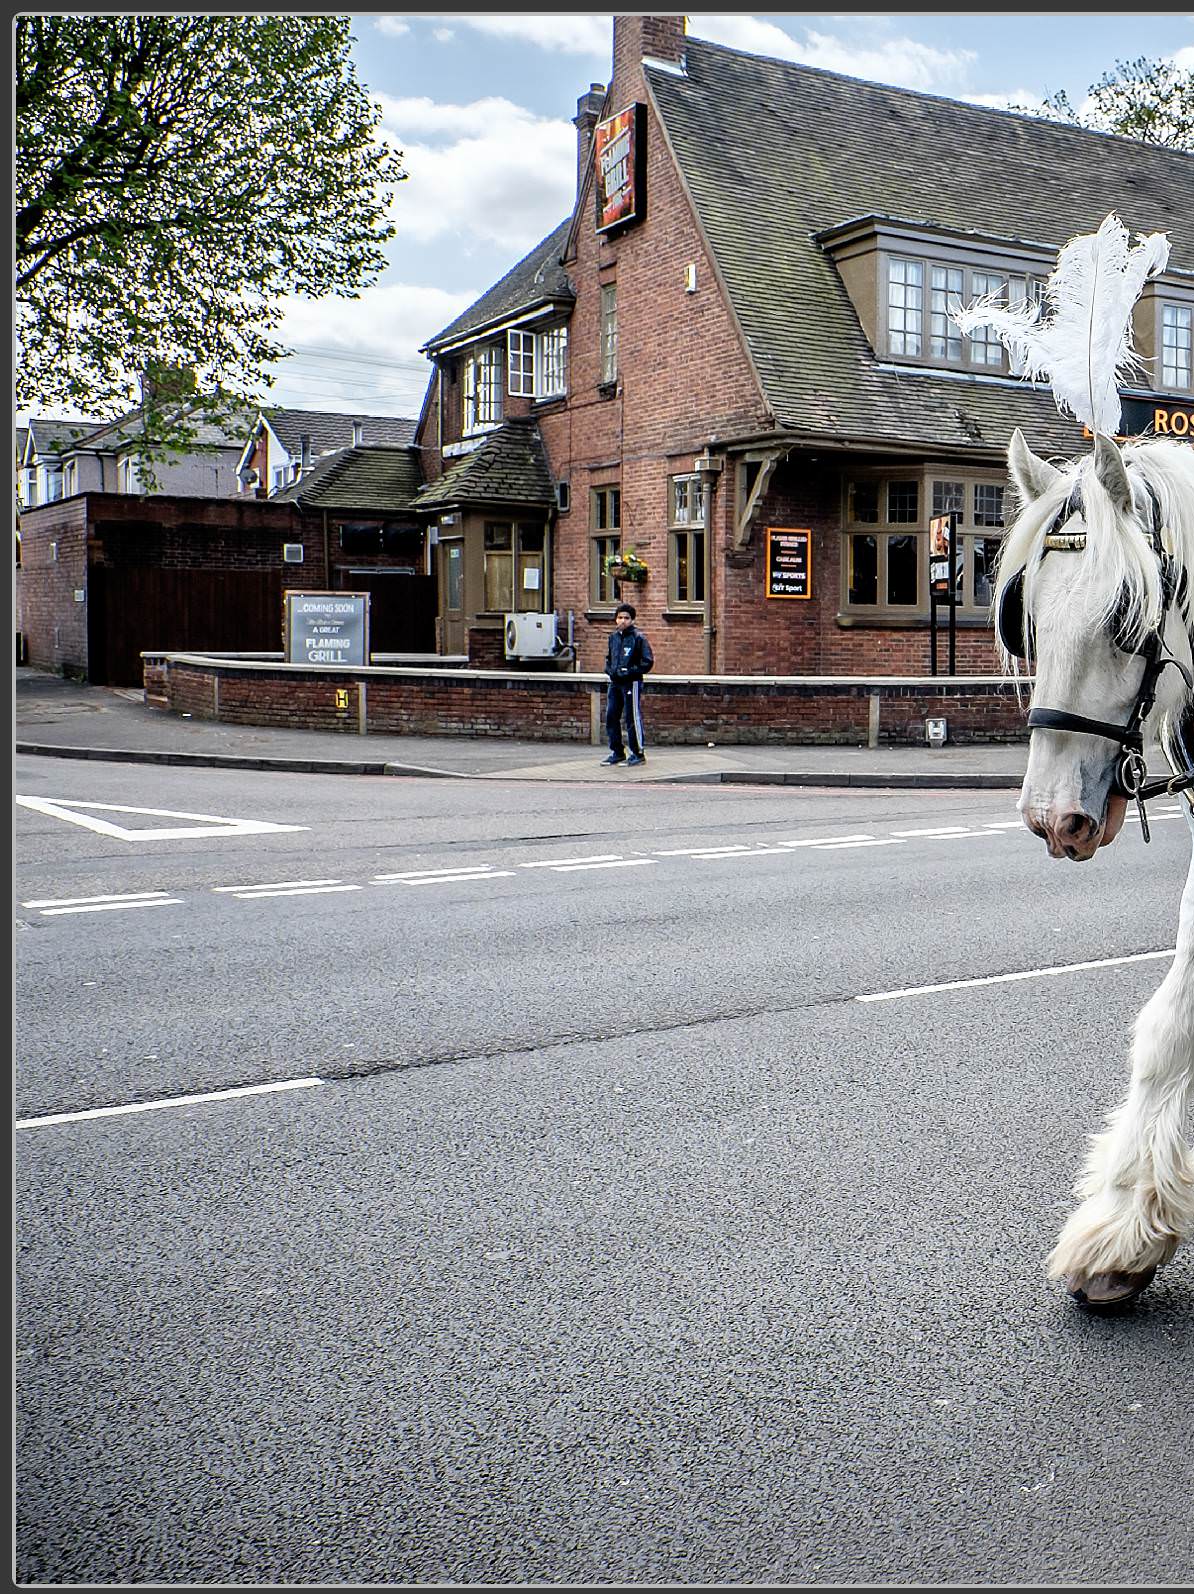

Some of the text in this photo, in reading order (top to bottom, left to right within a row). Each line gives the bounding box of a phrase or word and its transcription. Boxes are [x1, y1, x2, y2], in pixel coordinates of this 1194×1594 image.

[335, 603, 354, 613] SOON
[305, 638, 351, 649] FLAMING
[308, 650, 348, 662] GRILL
